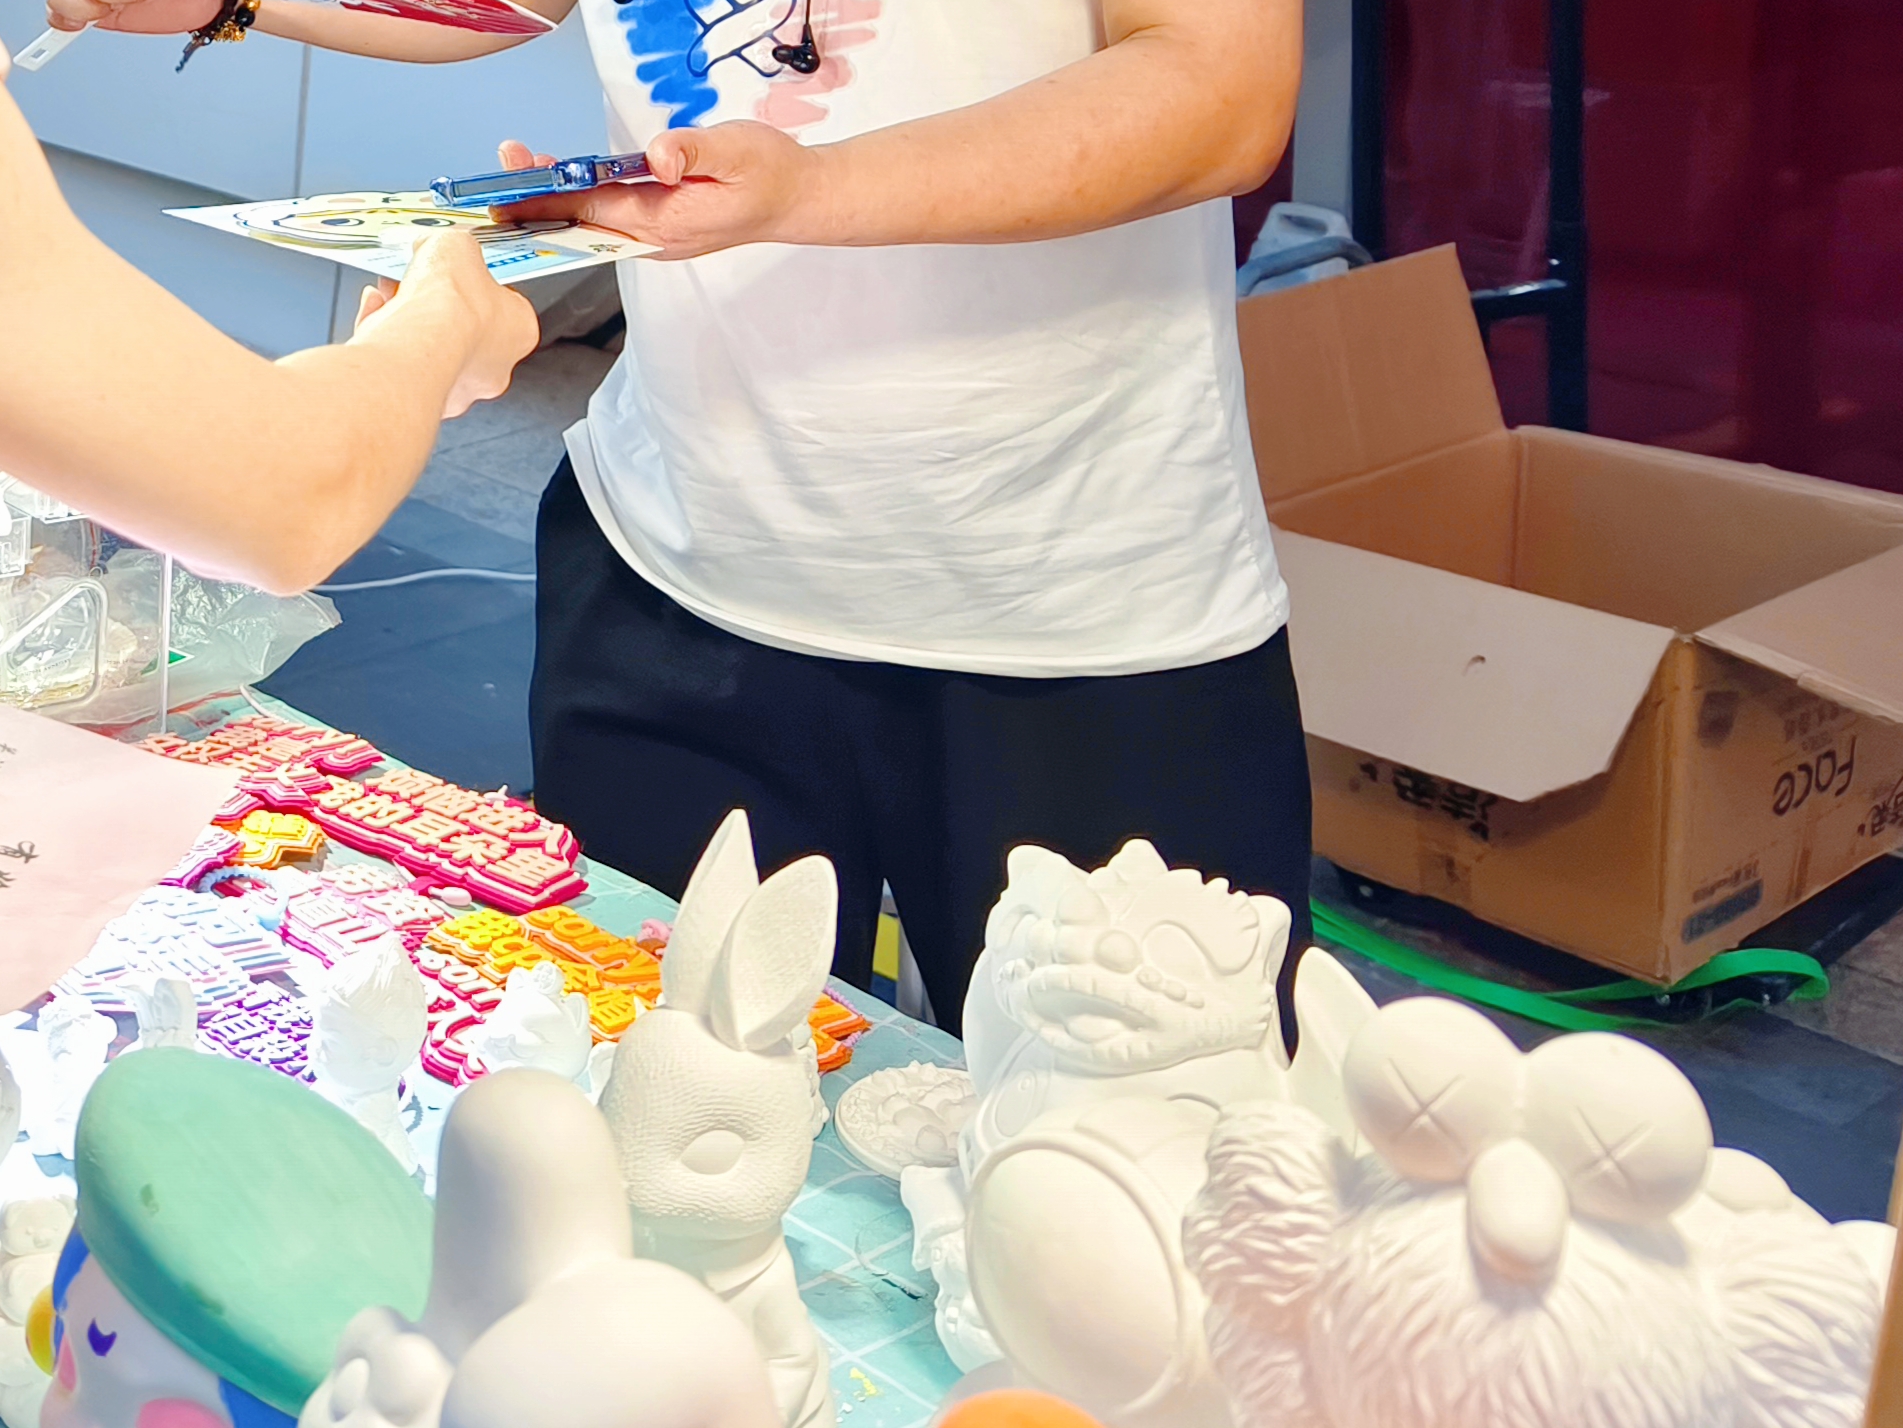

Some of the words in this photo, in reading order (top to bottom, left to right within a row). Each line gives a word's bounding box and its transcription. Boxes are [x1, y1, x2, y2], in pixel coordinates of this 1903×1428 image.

[365, 768, 564, 855] 烦恼进入
[1773, 736, 1857, 816] Face
[311, 774, 571, 888] 我的耳朵里
